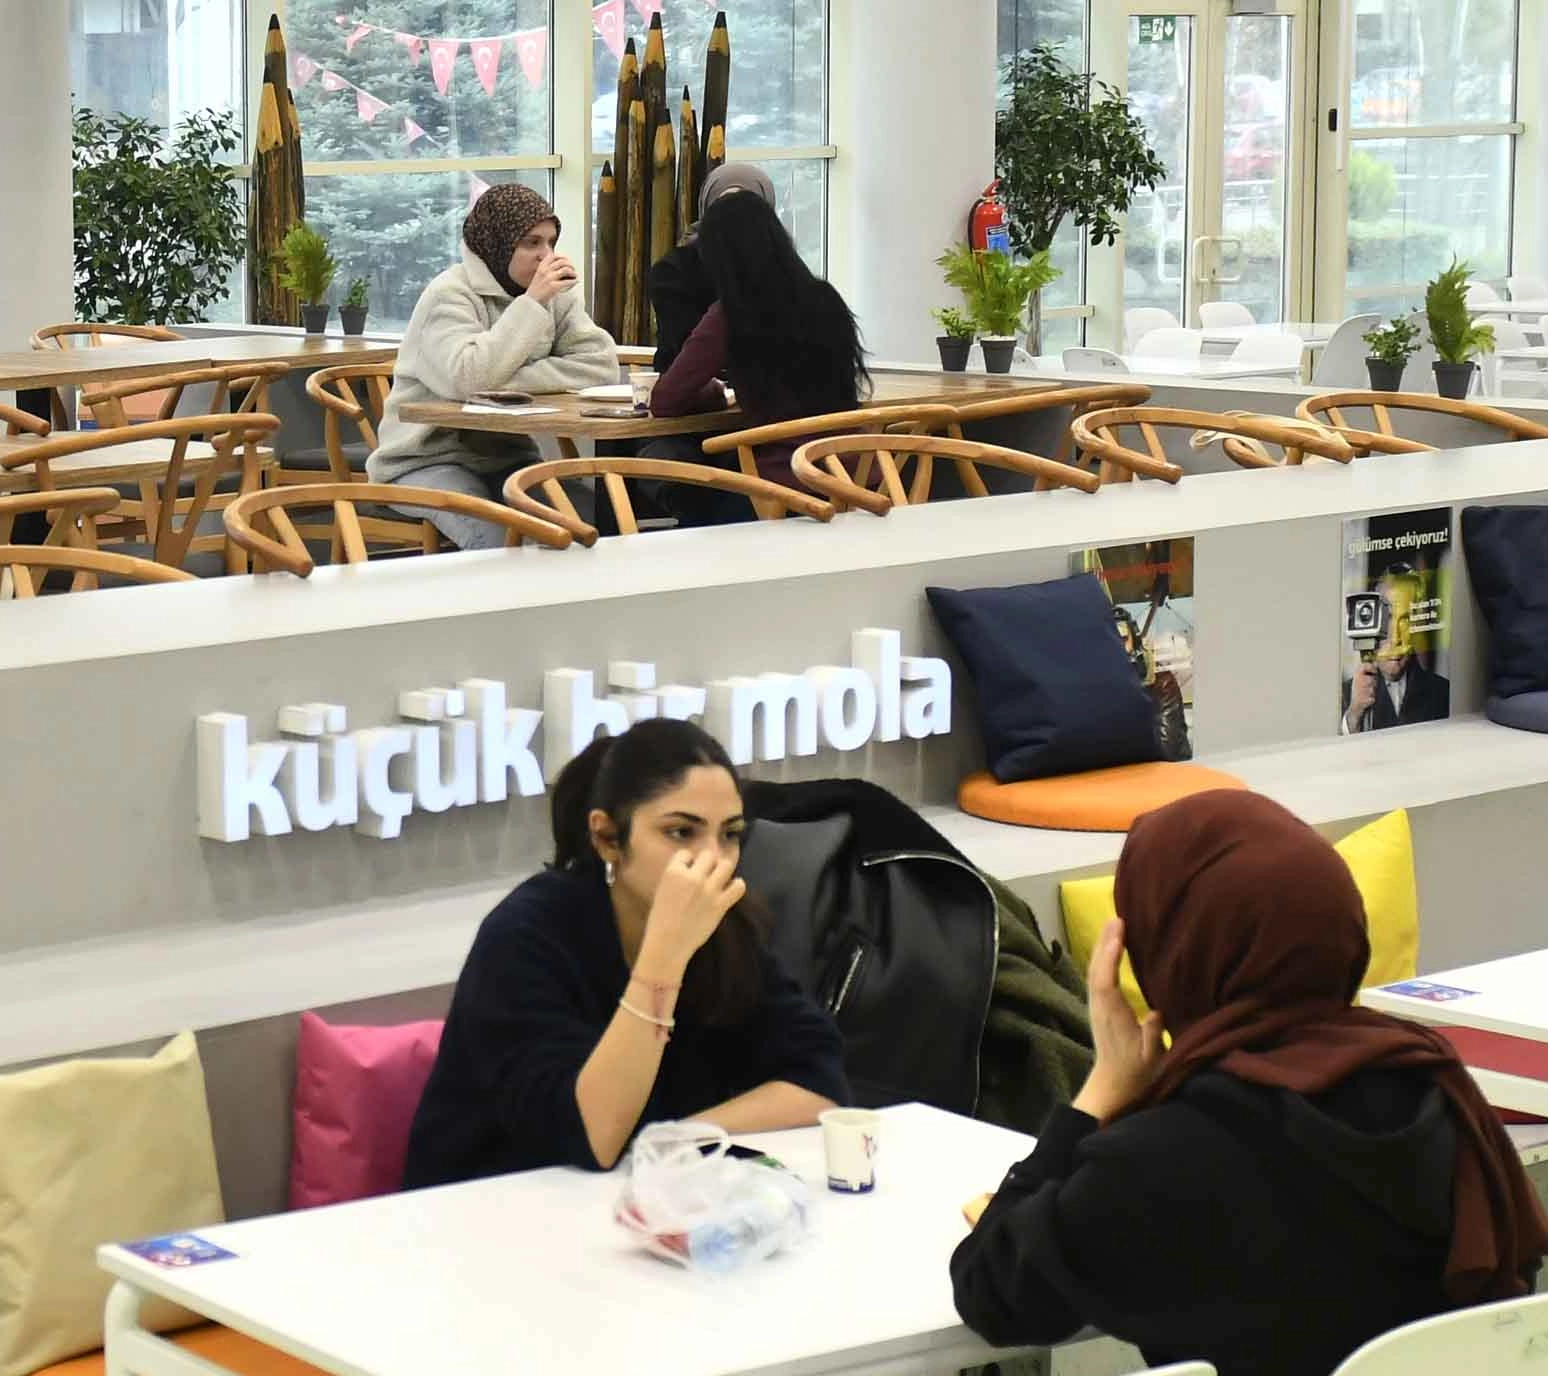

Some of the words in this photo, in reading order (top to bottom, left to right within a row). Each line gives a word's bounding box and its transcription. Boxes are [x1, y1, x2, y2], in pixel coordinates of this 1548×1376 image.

[1349, 534, 1393, 559] gülümse
[1395, 527, 1449, 551] çekiyoruz!
[197, 677, 544, 843] küçük
[705, 626, 952, 766] mola
